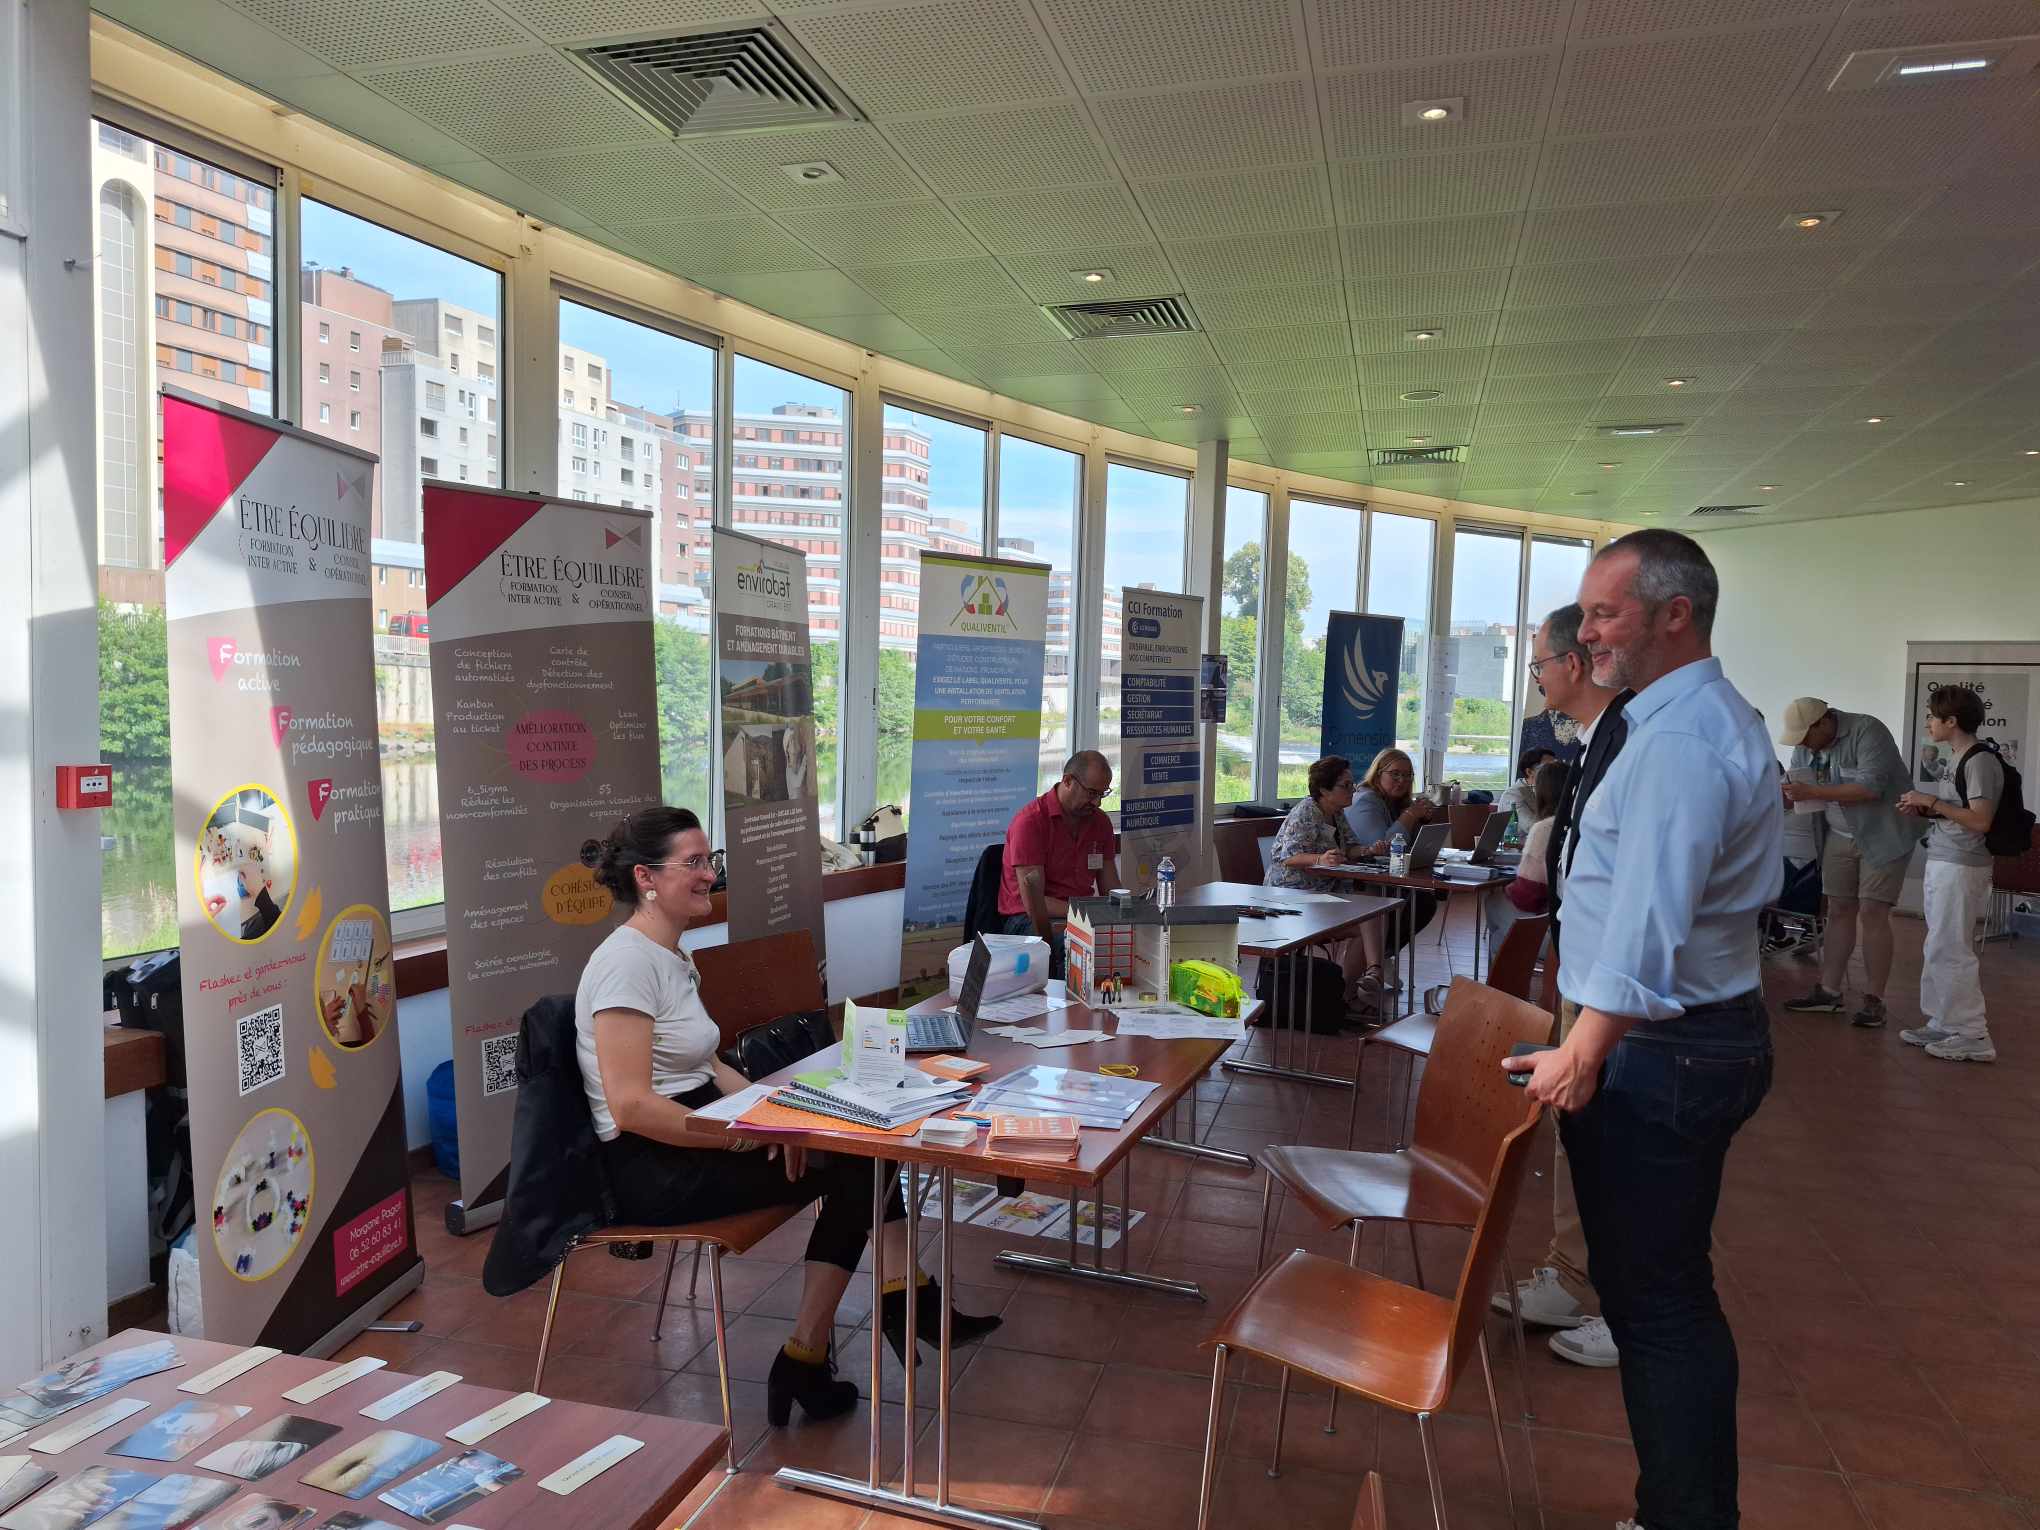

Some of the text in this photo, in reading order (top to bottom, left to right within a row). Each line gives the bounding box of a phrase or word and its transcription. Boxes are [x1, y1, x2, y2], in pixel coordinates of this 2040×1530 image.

[240, 494, 367, 554] ÊTRE ÉQUILIBRE
[250, 537, 294, 558] FORMATION
[309, 556, 318, 572] &
[500, 550, 646, 589] ÊTRE ÉQUILIBRE
[510, 581, 558, 594] FORMATION
[737, 571, 791, 599] envirobat
[571, 592, 580, 605] &
[1128, 600, 1183, 619] CCI Formation
[219, 644, 301, 667] Formation
[454, 647, 513, 661] Conception
[237, 673, 281, 692] active
[278, 711, 354, 731] Formation
[291, 734, 374, 766] pédagogique
[541, 757, 587, 773] PROCESS
[333, 802, 383, 834] pratique
